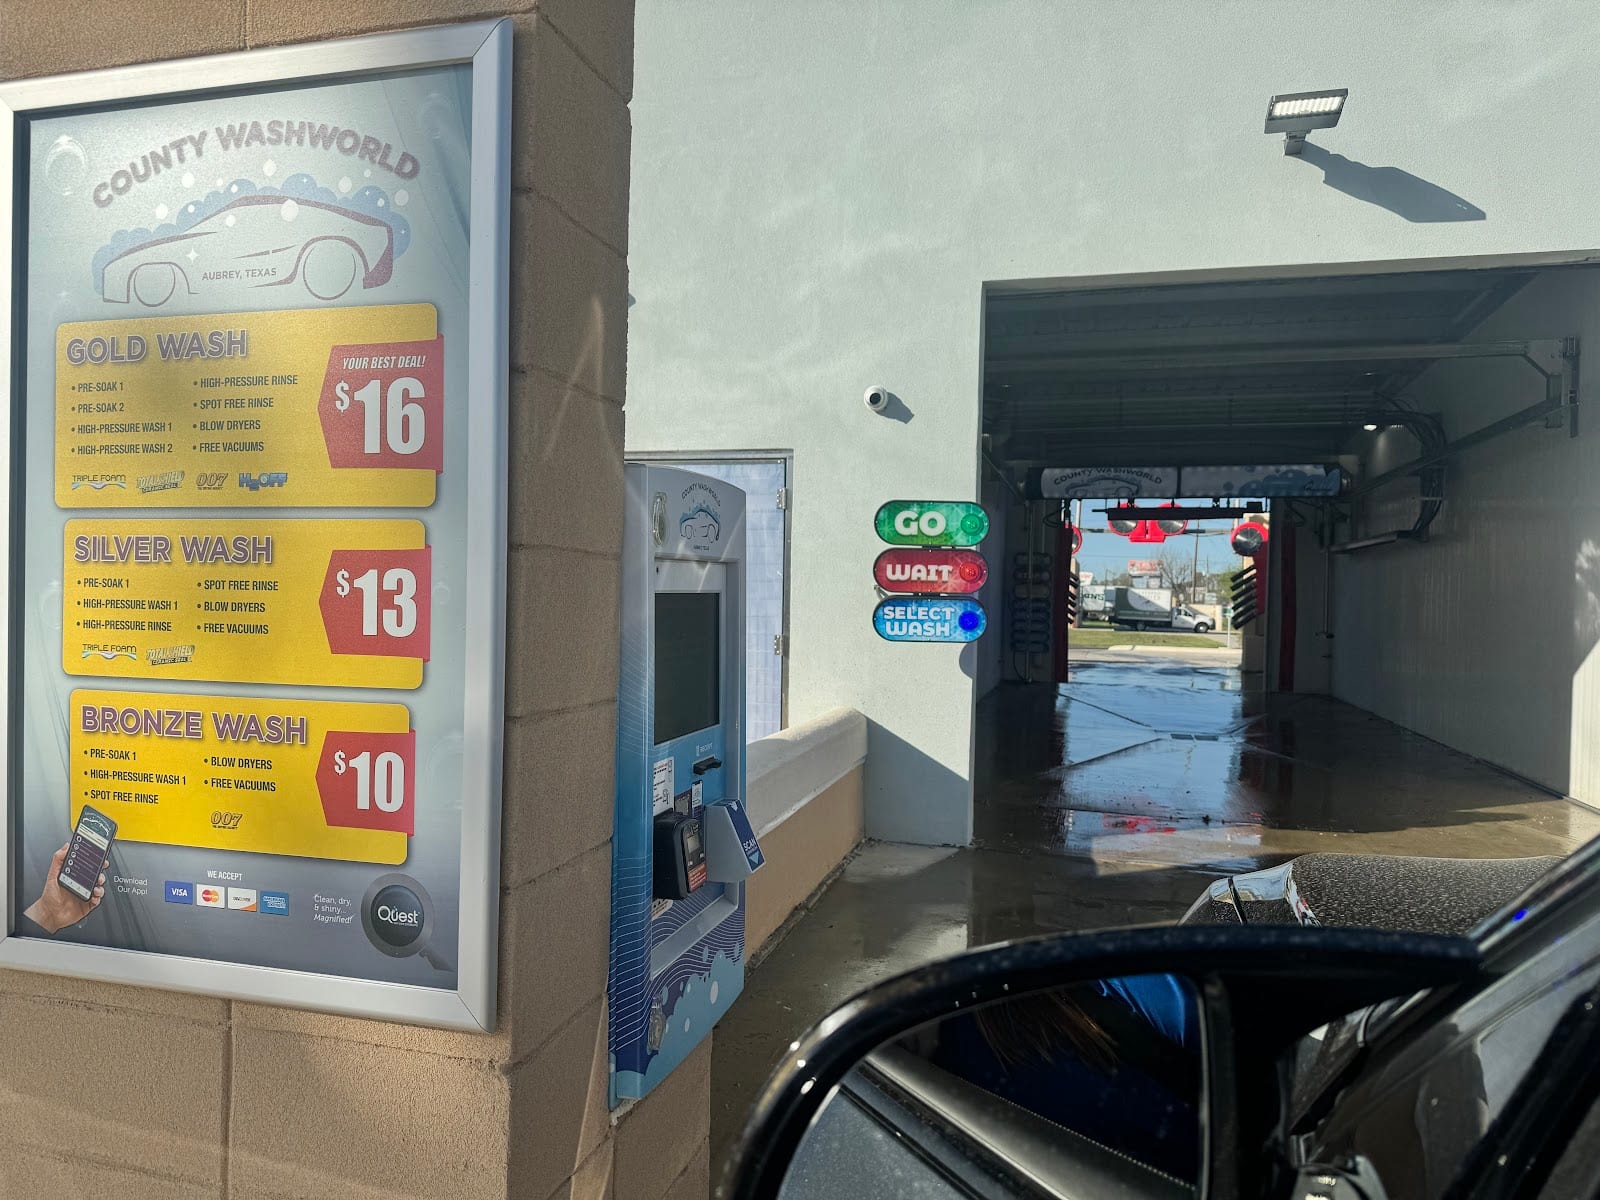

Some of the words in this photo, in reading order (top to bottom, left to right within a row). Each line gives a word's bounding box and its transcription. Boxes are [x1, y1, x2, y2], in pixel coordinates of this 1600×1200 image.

[93, 130, 208, 208] COUNTY
[215, 119, 421, 180] WASHWORLD
[202, 269, 243, 281] AUBREY,
[245, 267, 277, 278] TEXAS
[66, 335, 147, 365] GOLD
[156, 329, 247, 360] WASH
[342, 357, 369, 370] YOUR
[371, 356, 396, 369] BEST
[398, 355, 427, 368] DEAL!
[77, 382, 118, 393] PRE-SOAK
[119, 381, 124, 391] 1
[200, 375, 270, 388] HIGH-PRESSURE
[271, 374, 298, 386] RINSE
[77, 403, 118, 413] PRE-SOAK
[119, 403, 124, 412] 2
[200, 399, 223, 409] SPOT
[224, 398, 246, 409] FREE
[248, 397, 274, 408] RINSE
[335, 376, 426, 455] $16
[77, 423, 141, 434] HIGH-PRESSURE
[142, 422, 166, 432] WASH
[168, 422, 172, 432] 1
[200, 420, 225, 431] BLOW
[226, 420, 261, 430] DRYERS
[77, 444, 140, 455] HIGH-PRESSURE
[141, 443, 166, 454] WASH
[167, 443, 173, 453] 2
[200, 442, 221, 453] FREE
[222, 441, 264, 452] VACUUMS
[100, 474, 126, 482] FOAM
[196, 473, 228, 487] 007
[1054, 468, 1094, 485] COUNTY
[894, 510, 947, 537] GO
[74, 534, 171, 563] SILVER
[179, 535, 272, 564] WASH
[886, 563, 953, 582] WAIT
[83, 578, 123, 588] PRE-SOAK
[125, 579, 129, 588] 1
[204, 580, 226, 590] SPOT
[228, 580, 250, 590] FREE
[252, 580, 279, 591] RINSE
[83, 599, 146, 610] HIGH-PRESSURE
[147, 600, 172, 610] WASH
[174, 601, 178, 610] 1
[204, 601, 229, 612] BLOW
[231, 602, 265, 613] DRYERS
[336, 567, 417, 638] $13
[883, 606, 955, 620] SELECT
[83, 619, 146, 631] HIGH-PRESSURE
[147, 621, 172, 632] RINSE
[204, 623, 225, 634] FREE
[227, 624, 269, 635] VACUUMS
[885, 621, 950, 637] WASH
[82, 644, 109, 652] TRIPLE
[110, 645, 137, 653] FOAM
[80, 704, 202, 738] BRONZE
[211, 711, 307, 744] WASH
[90, 749, 130, 761] PRE-SOAK
[132, 751, 137, 761] 1
[211, 757, 236, 768] BLOW
[238, 758, 272, 770] DRYERS
[90, 769, 154, 783] HIGH-PRESSURE
[156, 773, 180, 785] WASH
[182, 776, 187, 785] 1
[334, 749, 405, 813] $10
[211, 778, 232, 789] FREE
[234, 780, 276, 792] VACUUMS
[90, 789, 111, 801] SPOT
[113, 791, 133, 802] FREE
[134, 793, 159, 804] RINSE
[211, 811, 243, 827] 007
[743, 837, 758, 852] SCAN
[113, 875, 148, 886] Download
[207, 870, 217, 879] WE
[218, 871, 243, 881] ACCEPT
[117, 886, 130, 894] Our
[131, 887, 148, 896] App!
[171, 887, 188, 897] VISA
[314, 894, 337, 905] Clean,
[338, 897, 352, 906] dry,
[322, 905, 346, 915] shiny...
[378, 905, 418, 924] Quest
[313, 914, 353, 924] Magnified!
